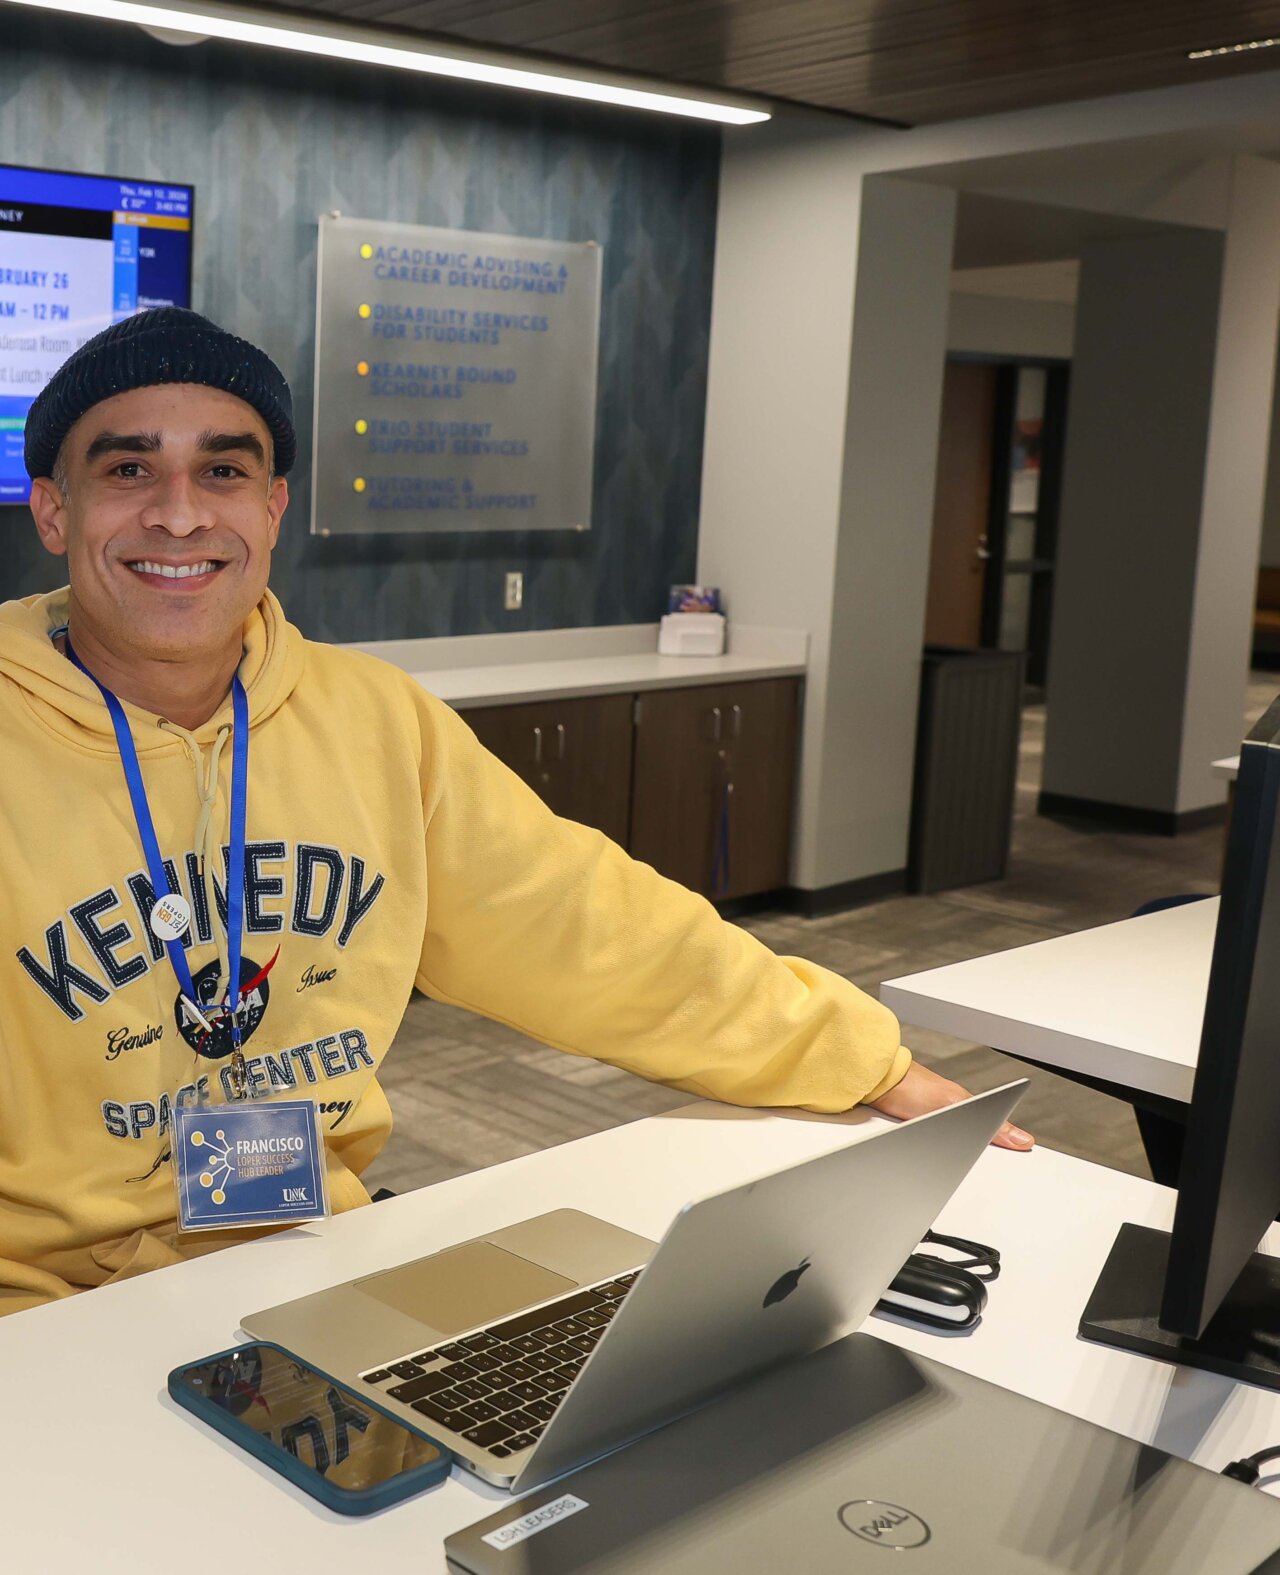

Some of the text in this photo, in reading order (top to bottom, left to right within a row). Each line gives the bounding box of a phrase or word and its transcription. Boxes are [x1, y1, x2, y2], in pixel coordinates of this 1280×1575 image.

[375, 245, 569, 279] ACADEMIC ADVISING &
[53, 272, 69, 289] 26
[374, 264, 567, 295] CAREER DEVELOPMENT
[51, 305, 69, 321] PM
[372, 303, 549, 333] DISABILITY SERVICES
[372, 322, 500, 346] FOR STUDENTS
[370, 362, 517, 385] KEARNEY BOUND
[369, 380, 463, 400] SCHOLARS
[416, 421, 493, 438] STUDENT
[368, 436, 446, 455] SUPPORT
[368, 477, 457, 494] TUTORING
[368, 493, 537, 511] ACADEMIC SUPPORT
[156, 907, 173, 923] GEN
[162, 901, 186, 921] LOPERS
[16, 840, 385, 1023] KENNEDY
[105, 1022, 164, 1061] Genuine
[236, 1136, 304, 1154] FRANCISCO
[237, 1153, 295, 1167] LOPER SUCCESS
[238, 1165, 284, 1177] HUB LEADER
[524, 1499, 577, 1531] LEADERS
[859, 1510, 910, 1538] DELL
